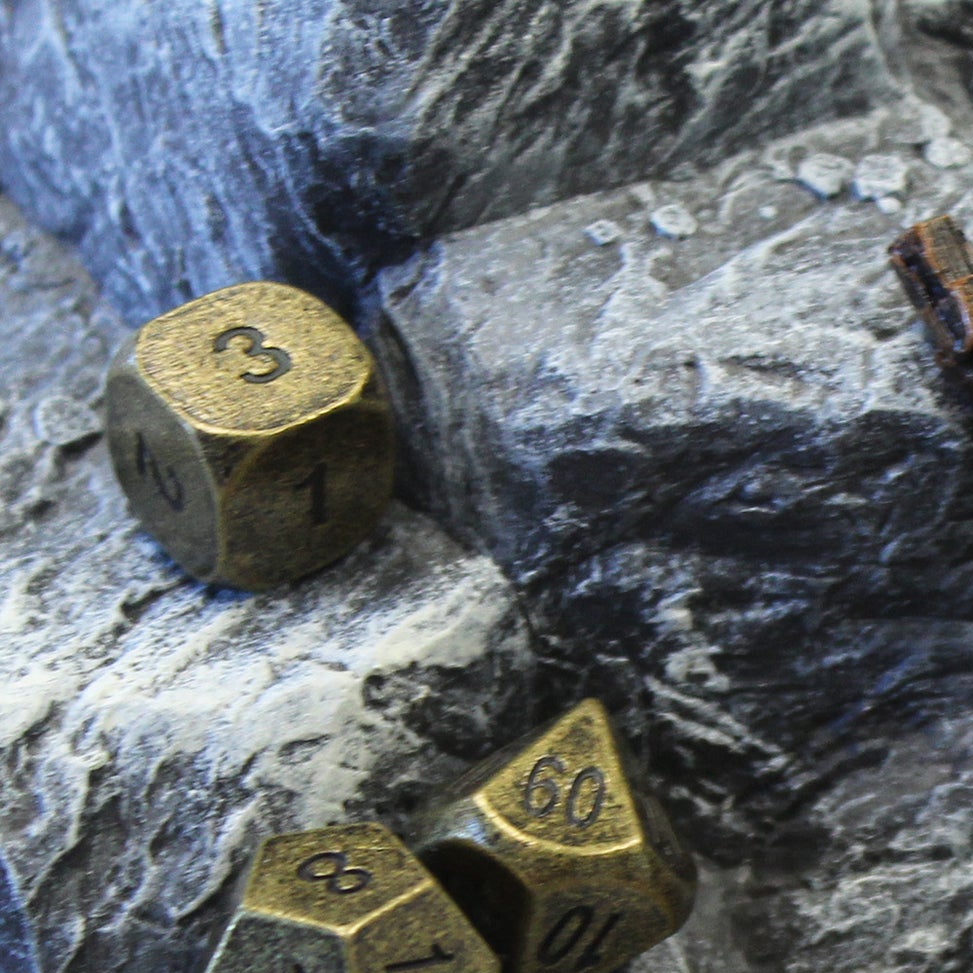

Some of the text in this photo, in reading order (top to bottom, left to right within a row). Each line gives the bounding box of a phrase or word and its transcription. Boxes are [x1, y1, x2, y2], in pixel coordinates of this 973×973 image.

[211, 325, 293, 385] 3
[293, 461, 329, 526] 1
[524, 754, 607, 828] 60
[297, 851, 373, 896] 8
[537, 904, 622, 969] 10
